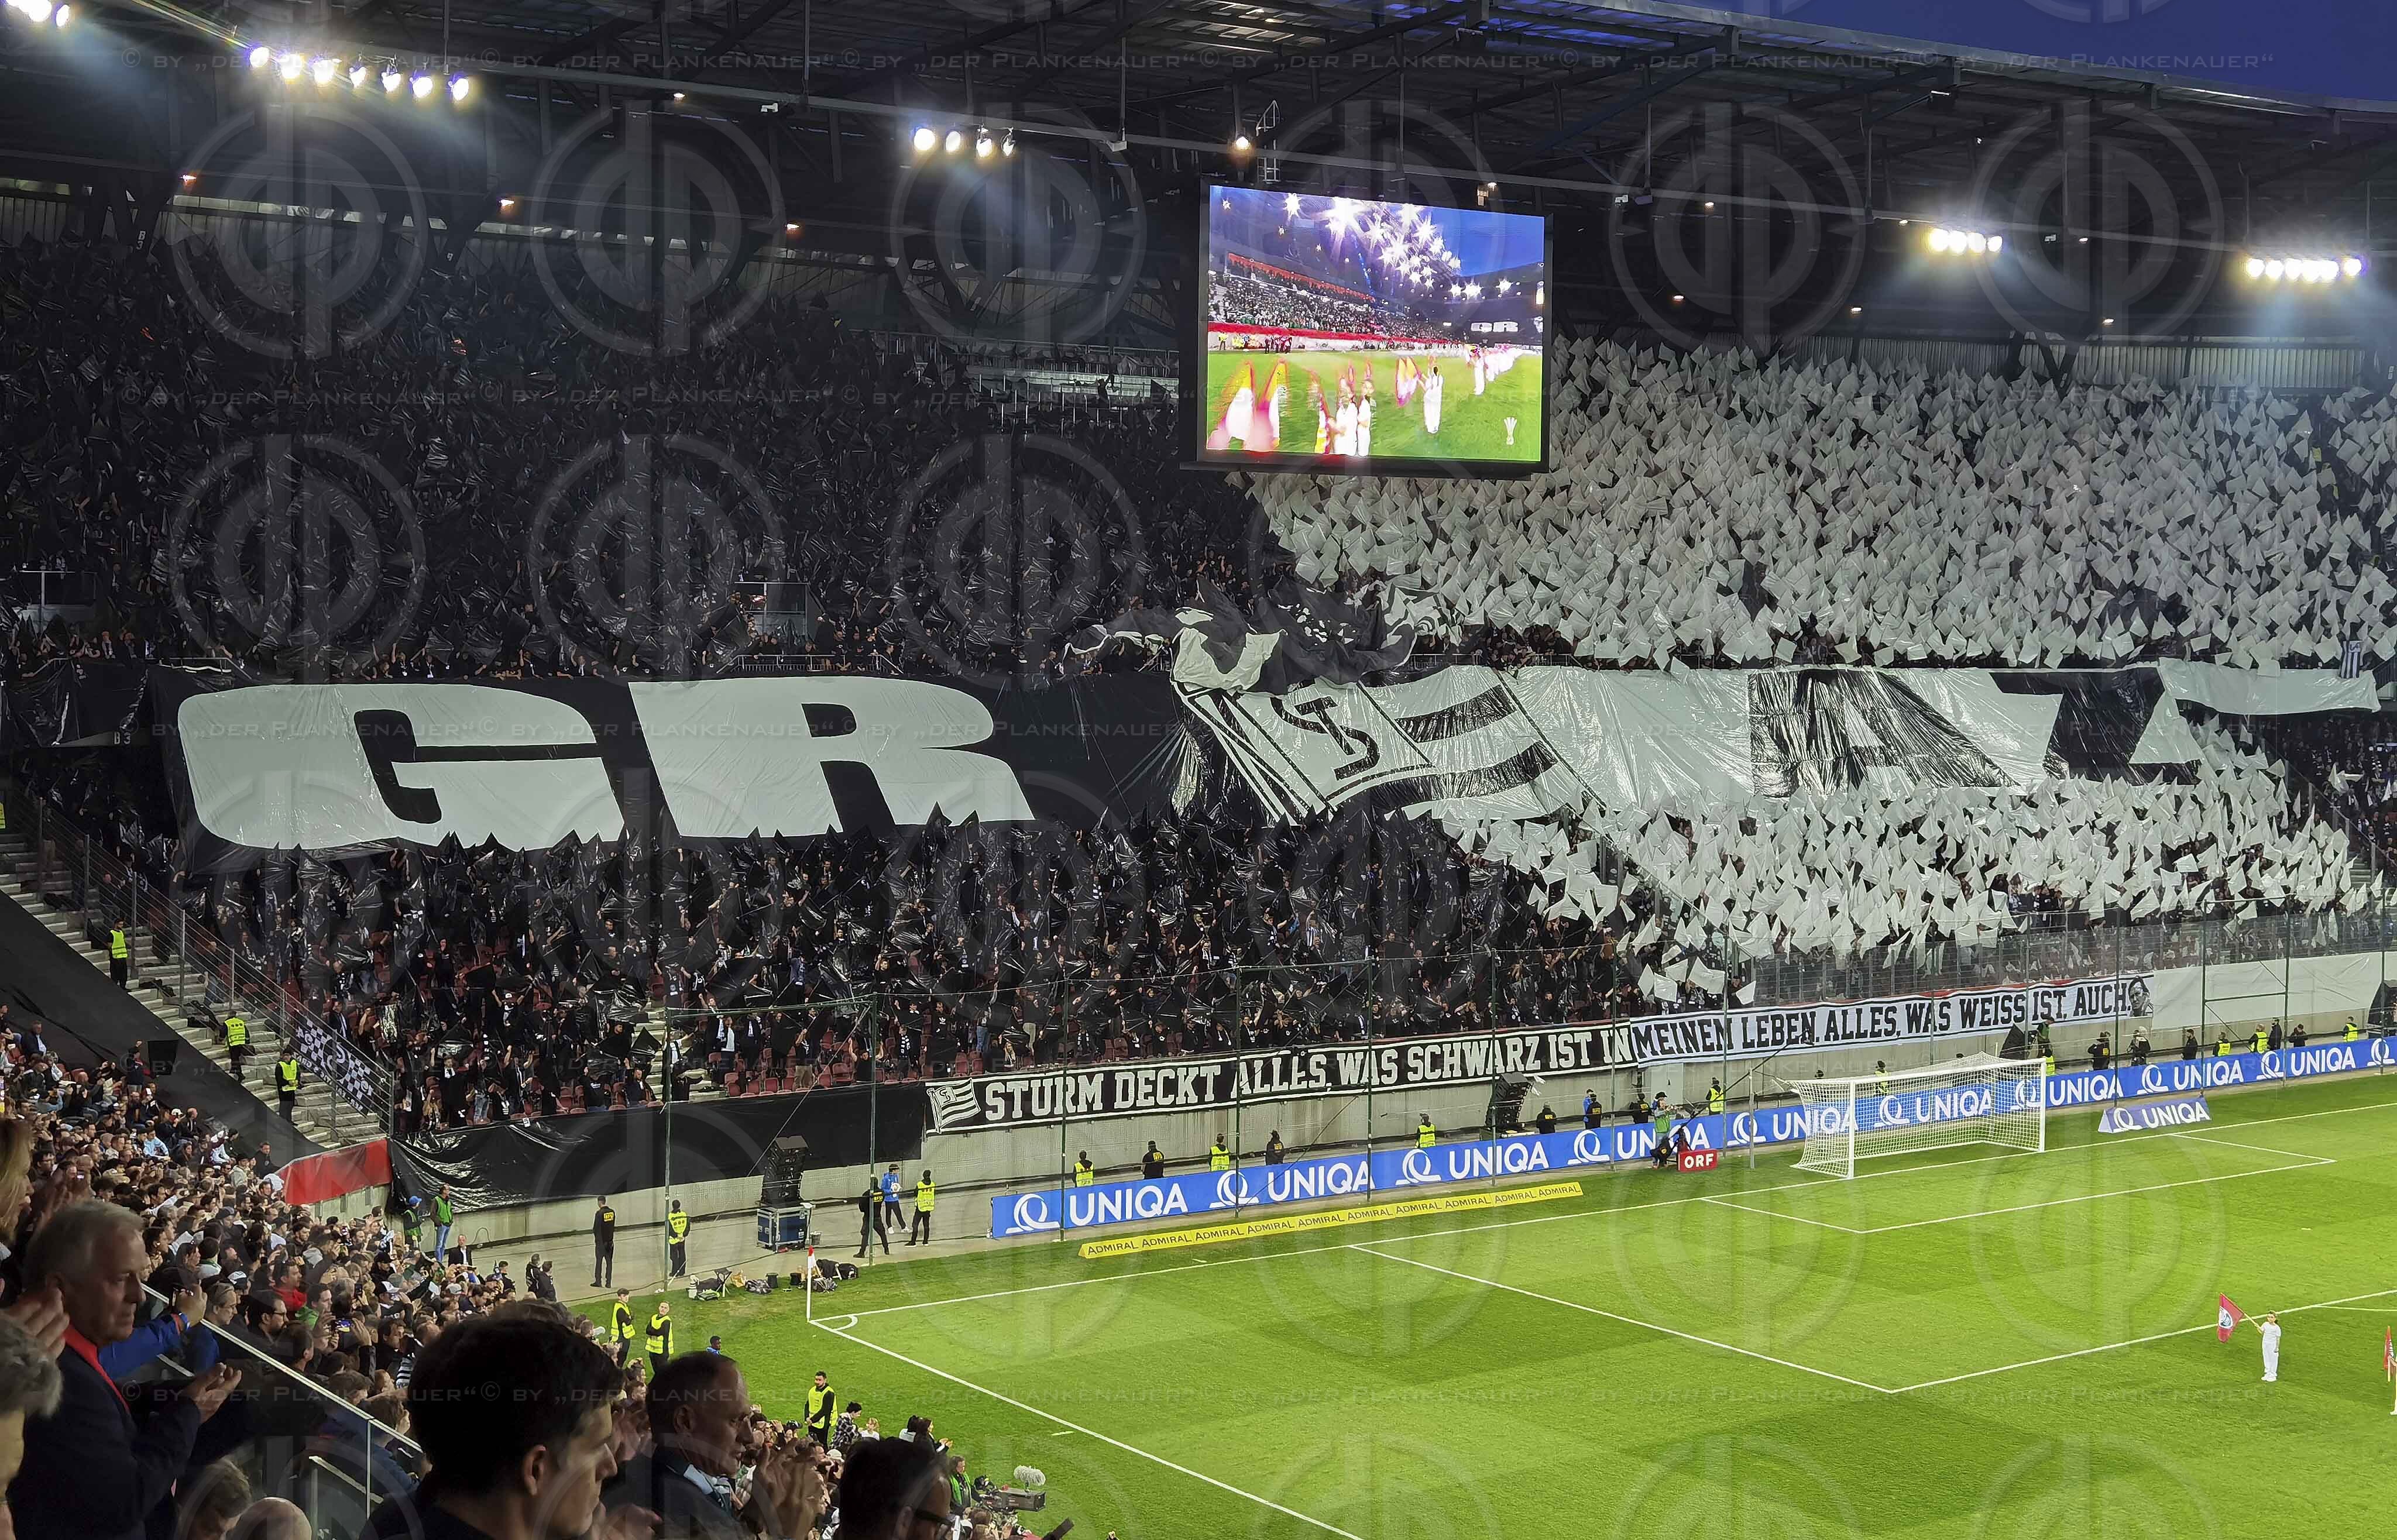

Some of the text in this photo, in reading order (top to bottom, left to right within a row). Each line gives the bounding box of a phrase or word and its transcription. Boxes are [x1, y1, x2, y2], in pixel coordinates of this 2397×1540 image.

[1633, 1018, 1733, 1058] MEINEN
[1906, 1001, 1952, 1034] WAS
[1959, 994, 2025, 1029] WEISS
[985, 1072, 1104, 1121] STURM
[1114, 1065, 1221, 1109] DECKT
[1337, 1048, 1398, 1086] WAS
[1407, 1035, 1541, 1082] SCHWARZ
[1548, 1031, 1592, 1069] IST
[1600, 1027, 1633, 1063] IN
[2173, 1060, 2244, 1090] UNIQA
[2291, 1046, 2356, 1076] UNIQA
[1916, 1090, 1991, 1123] UNIQA
[2049, 1073, 2124, 1106] UNIQA
[1773, 1107, 1859, 1140] UNIQA
[2142, 1101, 2211, 1129] UNIQA
[1617, 1123, 1711, 1160] UNQA
[1449, 1140, 1551, 1179] UNIQA
[1684, 1153, 1715, 1169] ORF
[1268, 1160, 1375, 1201] UNIQA
[1070, 1182, 1189, 1226] UNIQA
[1087, 1184, 1581, 1256] ADMIRAL ADMIRAL ADMIRAL ADMIRAL ADMIRAL ADMIRAL ADMIRAL ADMIRAL ADMIRAL ADMIRAL
